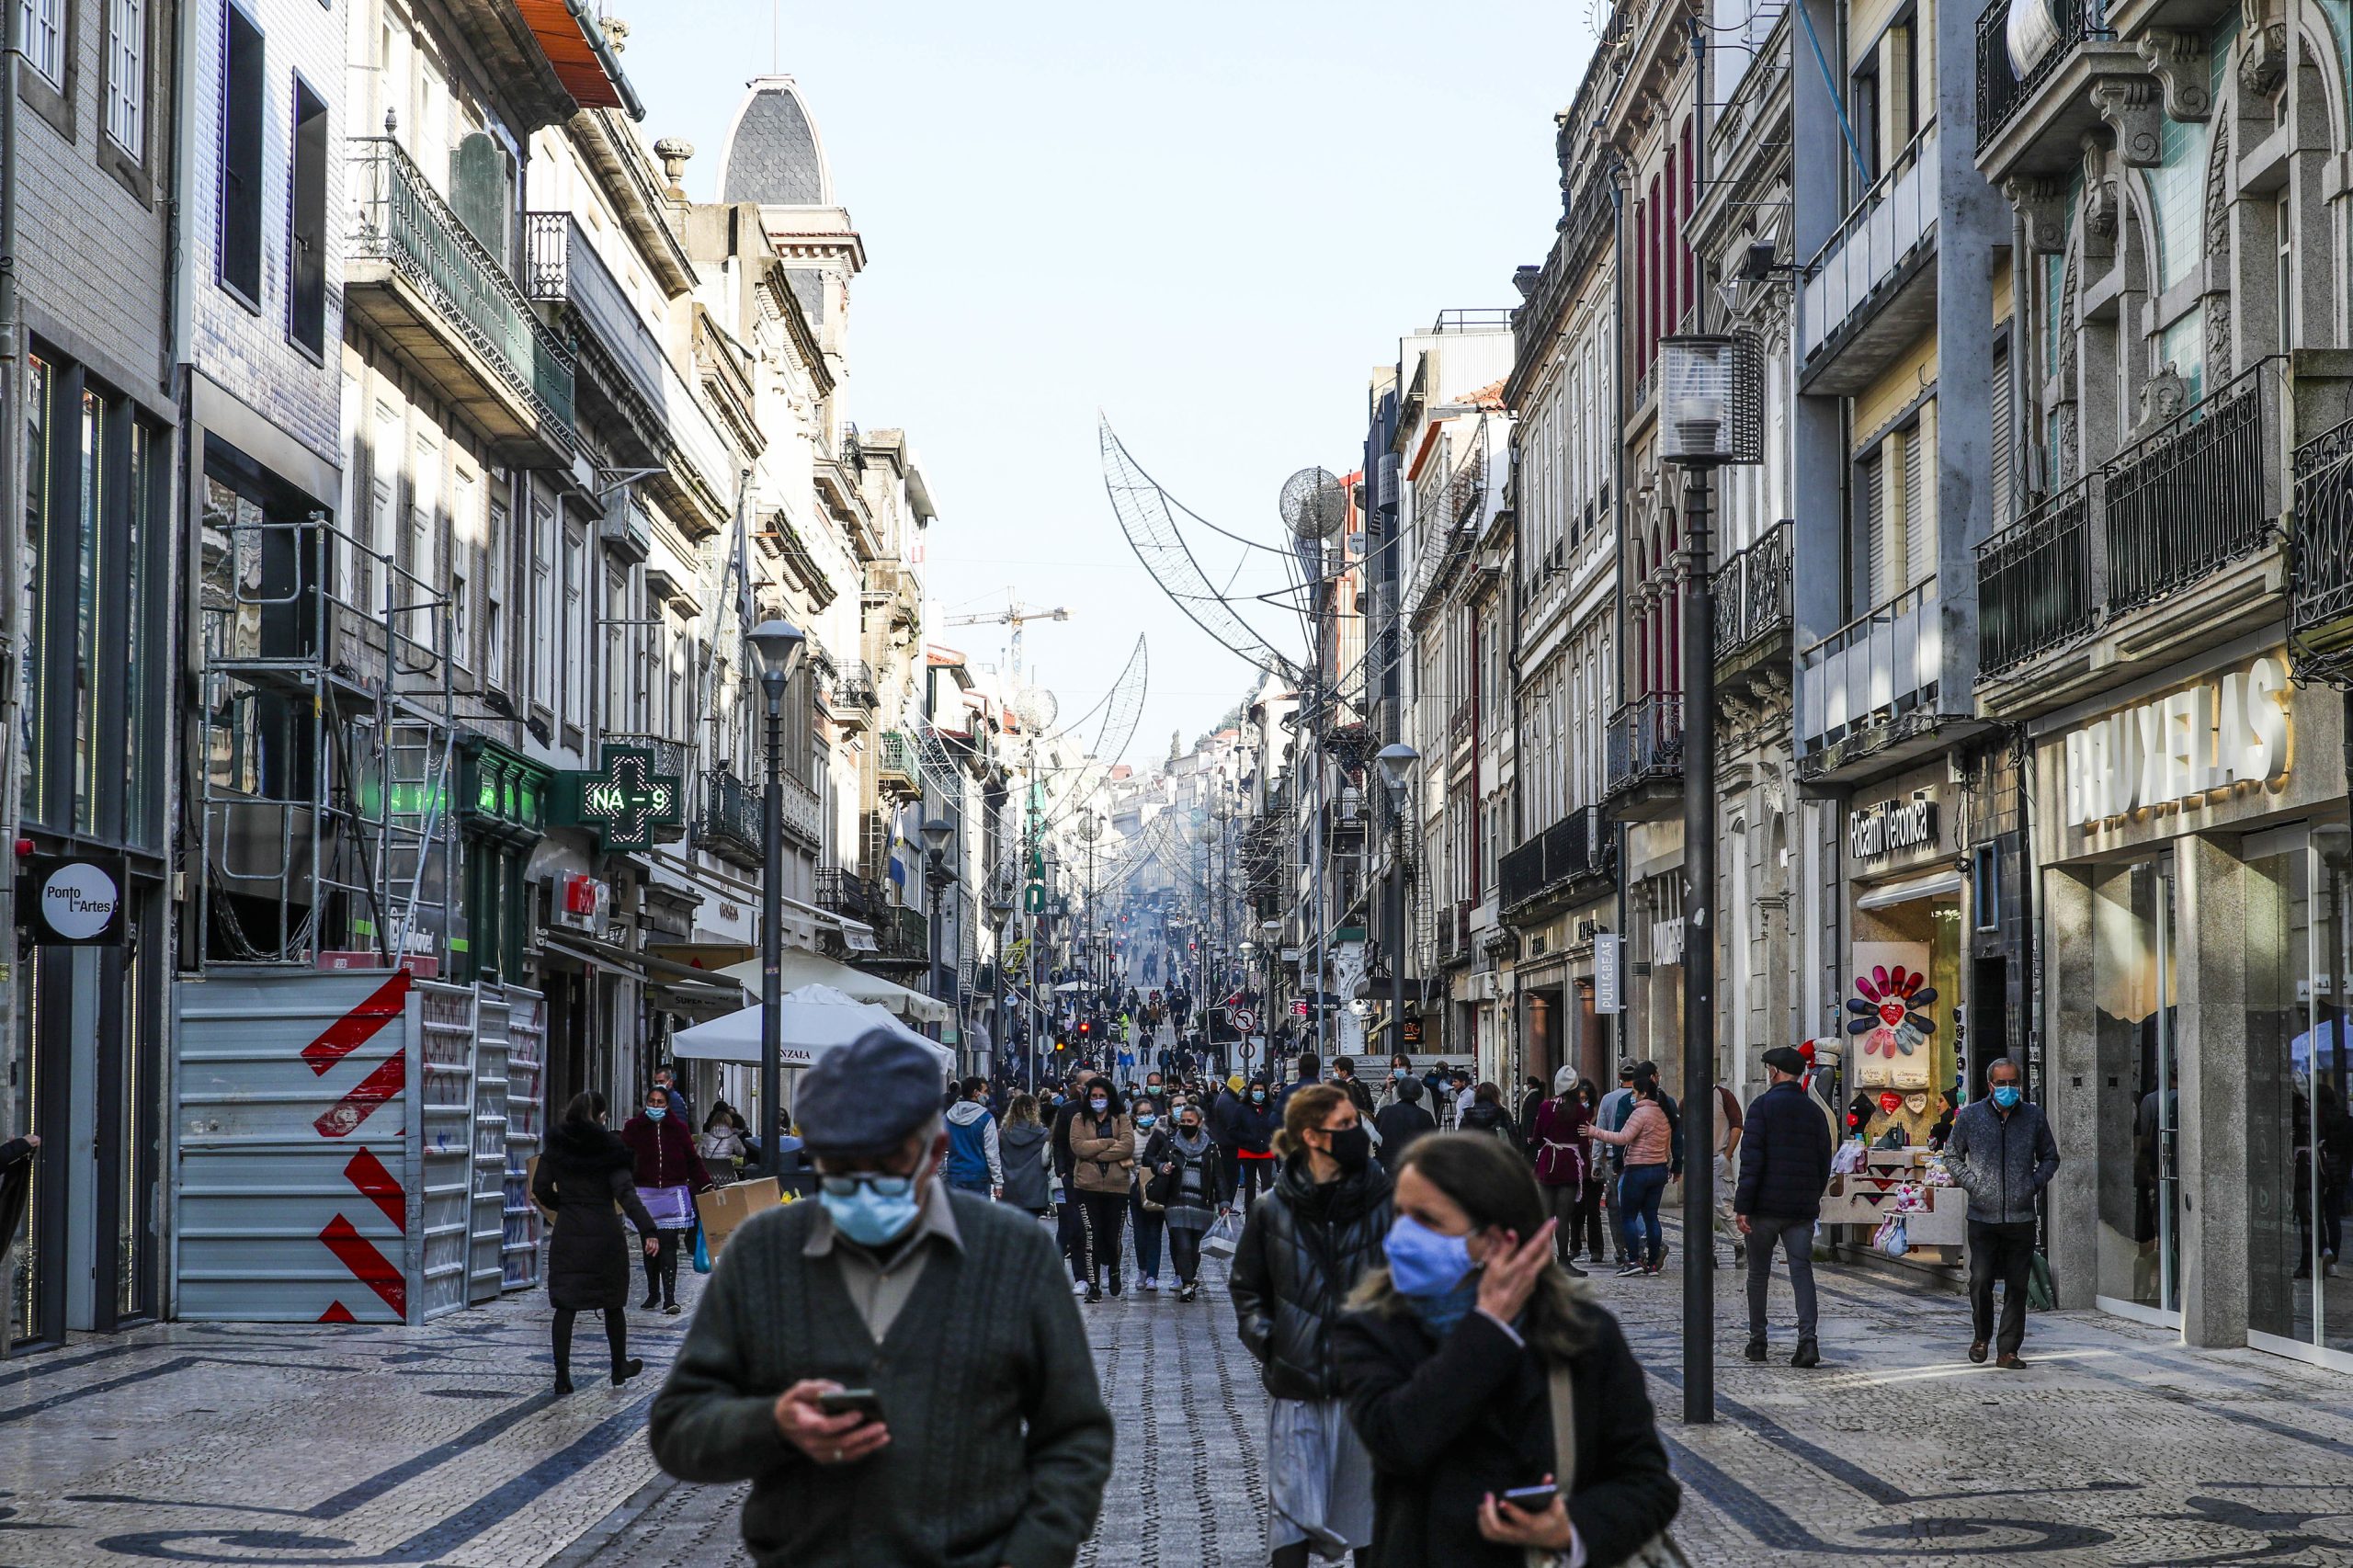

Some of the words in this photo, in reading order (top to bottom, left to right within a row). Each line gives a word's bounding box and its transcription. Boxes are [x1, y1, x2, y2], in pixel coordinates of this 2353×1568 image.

[2066, 658, 2287, 827] BRUXELAS
[593, 789, 625, 809] NA
[1850, 802, 1881, 858] Ricami
[1881, 791, 1927, 851] Veronica
[80, 901, 111, 913] Artes
[1601, 940, 1613, 1008] PULL&BEAR
